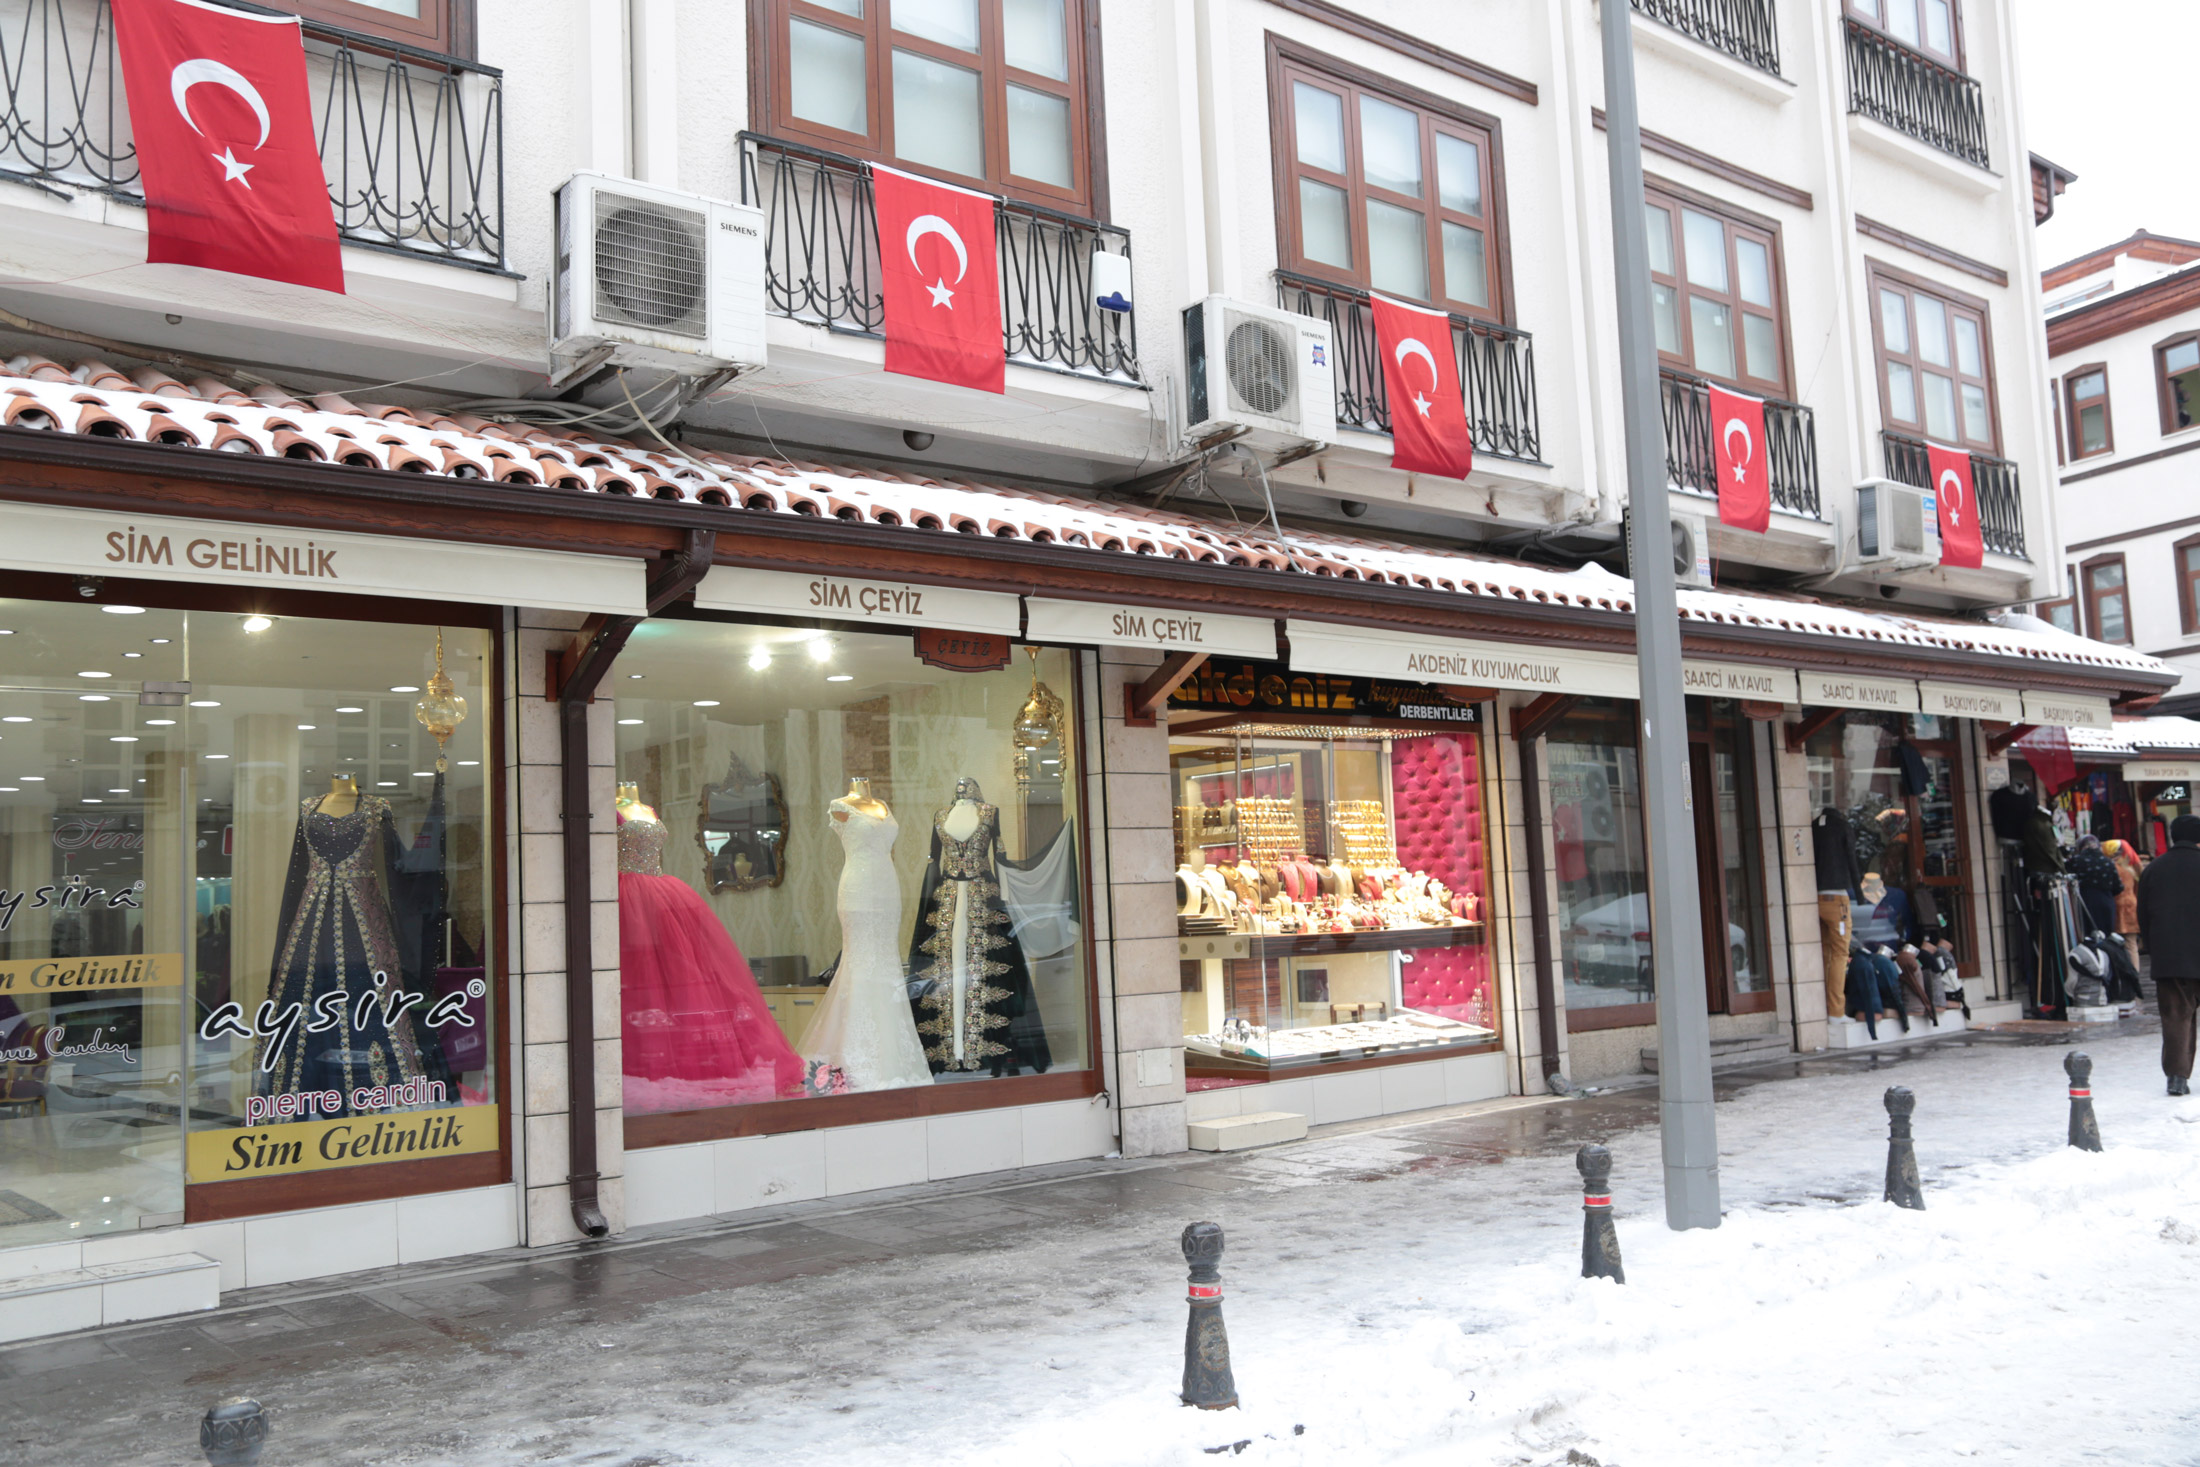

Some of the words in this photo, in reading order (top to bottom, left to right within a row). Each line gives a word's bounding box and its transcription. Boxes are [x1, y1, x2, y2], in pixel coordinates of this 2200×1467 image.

[720, 222, 758, 237] SIEMENS
[1301, 330, 1326, 341] SIEMENS
[105, 526, 174, 566] SİM
[186, 537, 339, 579] GELİNLİK
[809, 577, 852, 610] SİM
[859, 585, 923, 616] ÇEYİZ
[1112, 609, 1147, 638] SİM
[1152, 616, 1203, 644] ÇEYİZ
[937, 637, 991, 657] ÇEYİZ
[1407, 652, 1468, 677] AKDENİZ
[1472, 658, 1561, 684] KUYUMCULUK
[1684, 669, 1723, 689] SAATCİ
[1727, 675, 1774, 693] M.YAVUZ
[1822, 682, 1855, 700] SAATCİ
[1859, 686, 1899, 704] M.YAVUZ
[30, 959, 162, 989] Gelinlik
[351, 1075, 446, 1110] cardin
[224, 1133, 303, 1172] Sim
[319, 1115, 465, 1161] Gelinlik
